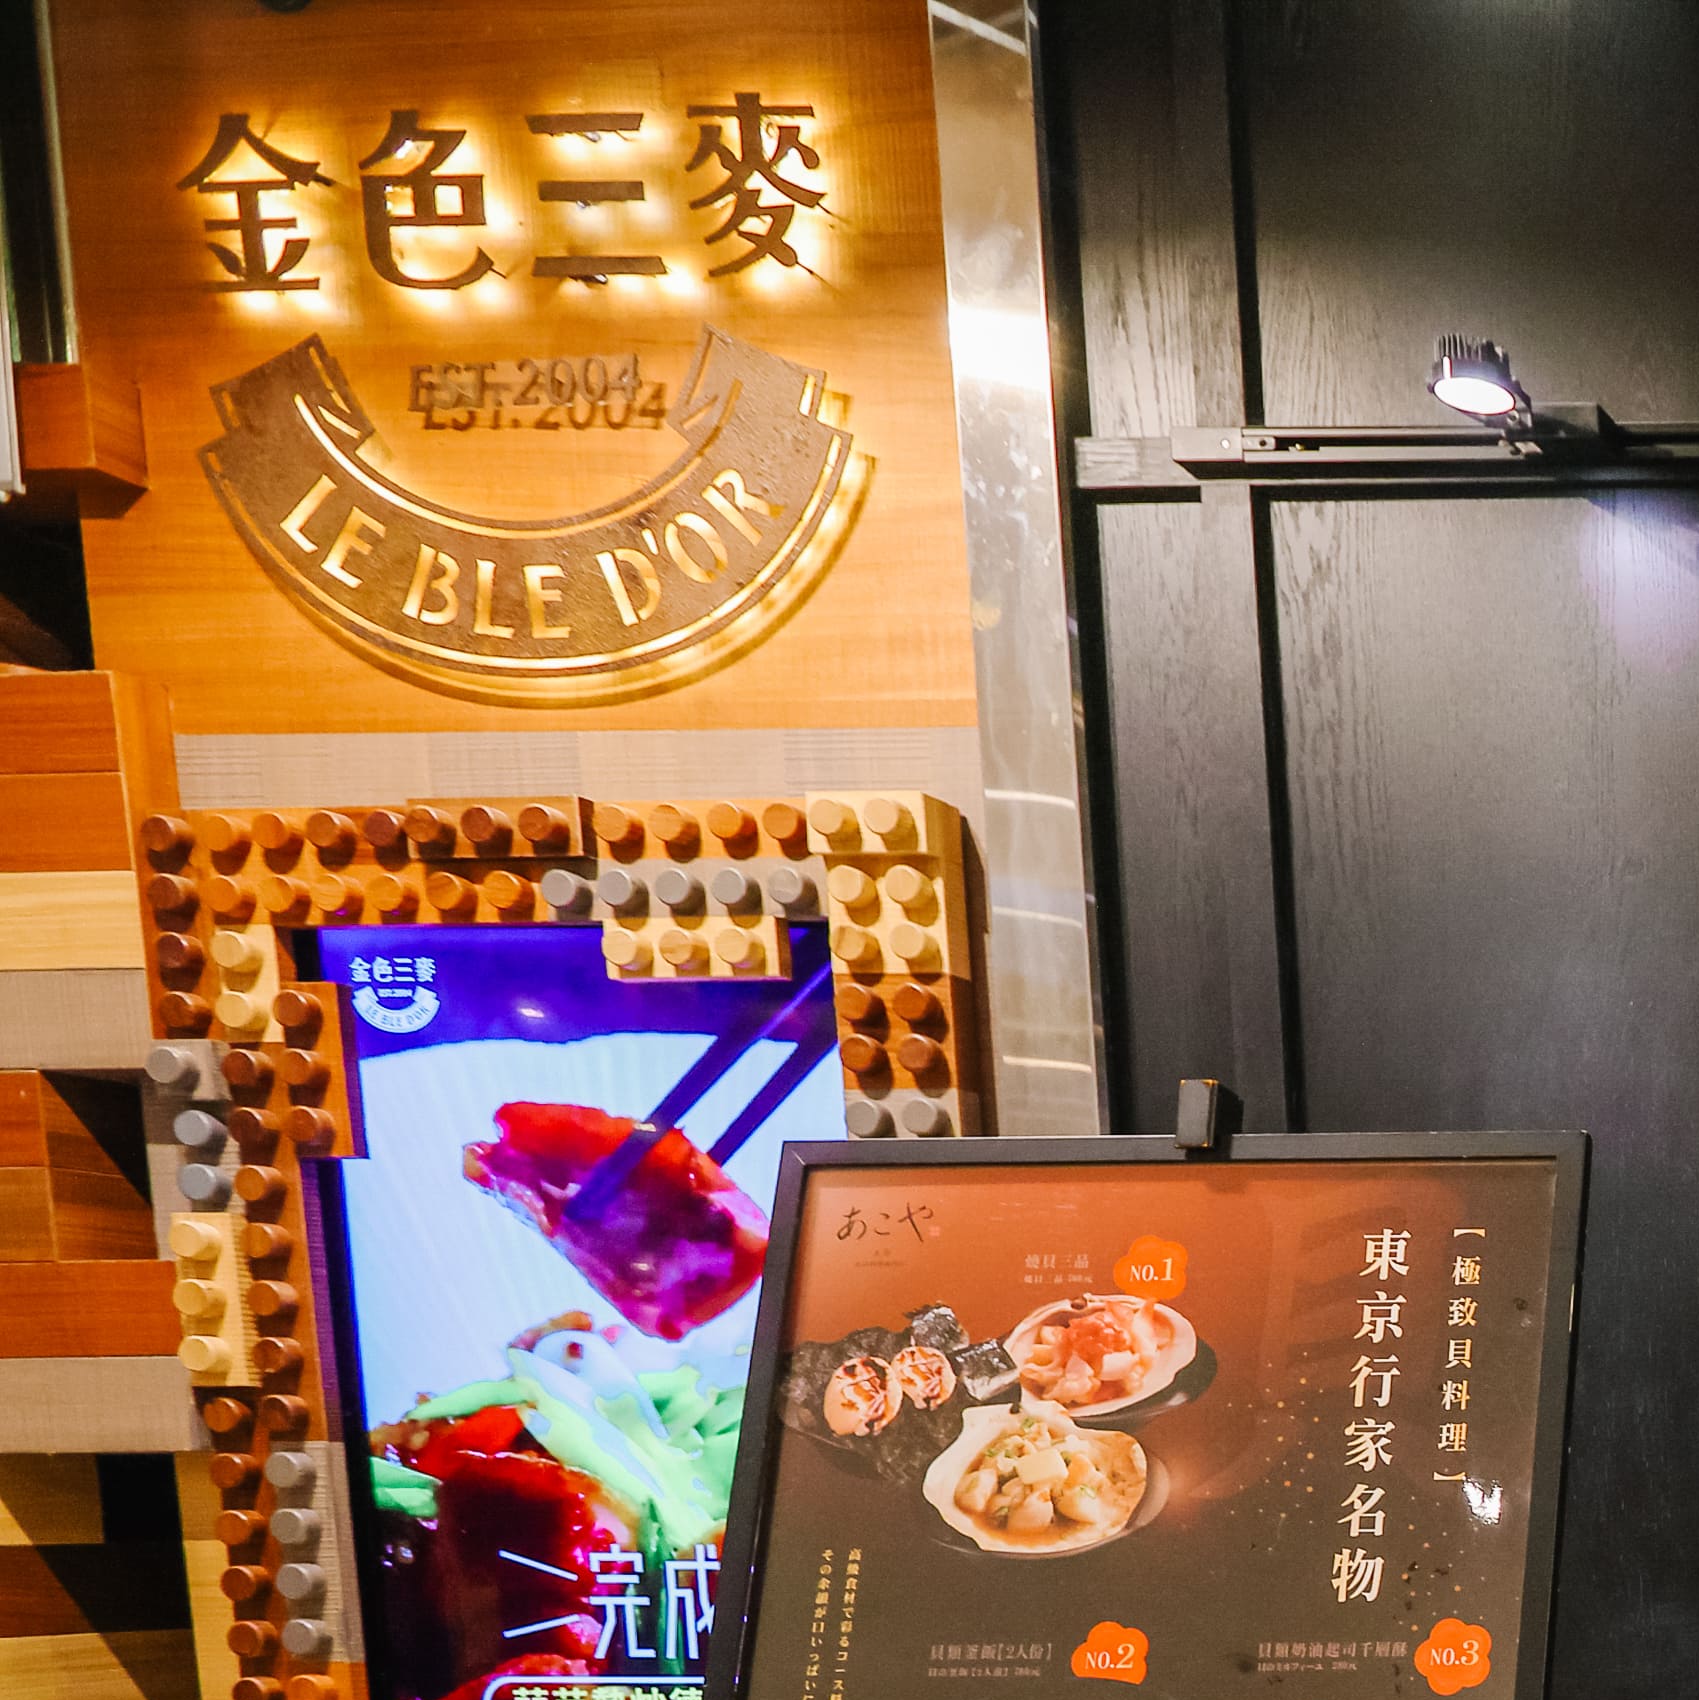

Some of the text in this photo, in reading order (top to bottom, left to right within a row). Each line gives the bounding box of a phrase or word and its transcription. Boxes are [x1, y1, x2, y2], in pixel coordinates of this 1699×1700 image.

[177, 92, 827, 292] 金色三麥
[279, 466, 781, 640] LE BLE D'OR
[836, 1203, 934, 1243] あこや
[1129, 1257, 1176, 1283] NO.1
[1330, 1228, 1412, 1603] 東京行家名物
[1085, 1643, 1135, 1670] NO.2
[1429, 1639, 1480, 1667] NO.3
